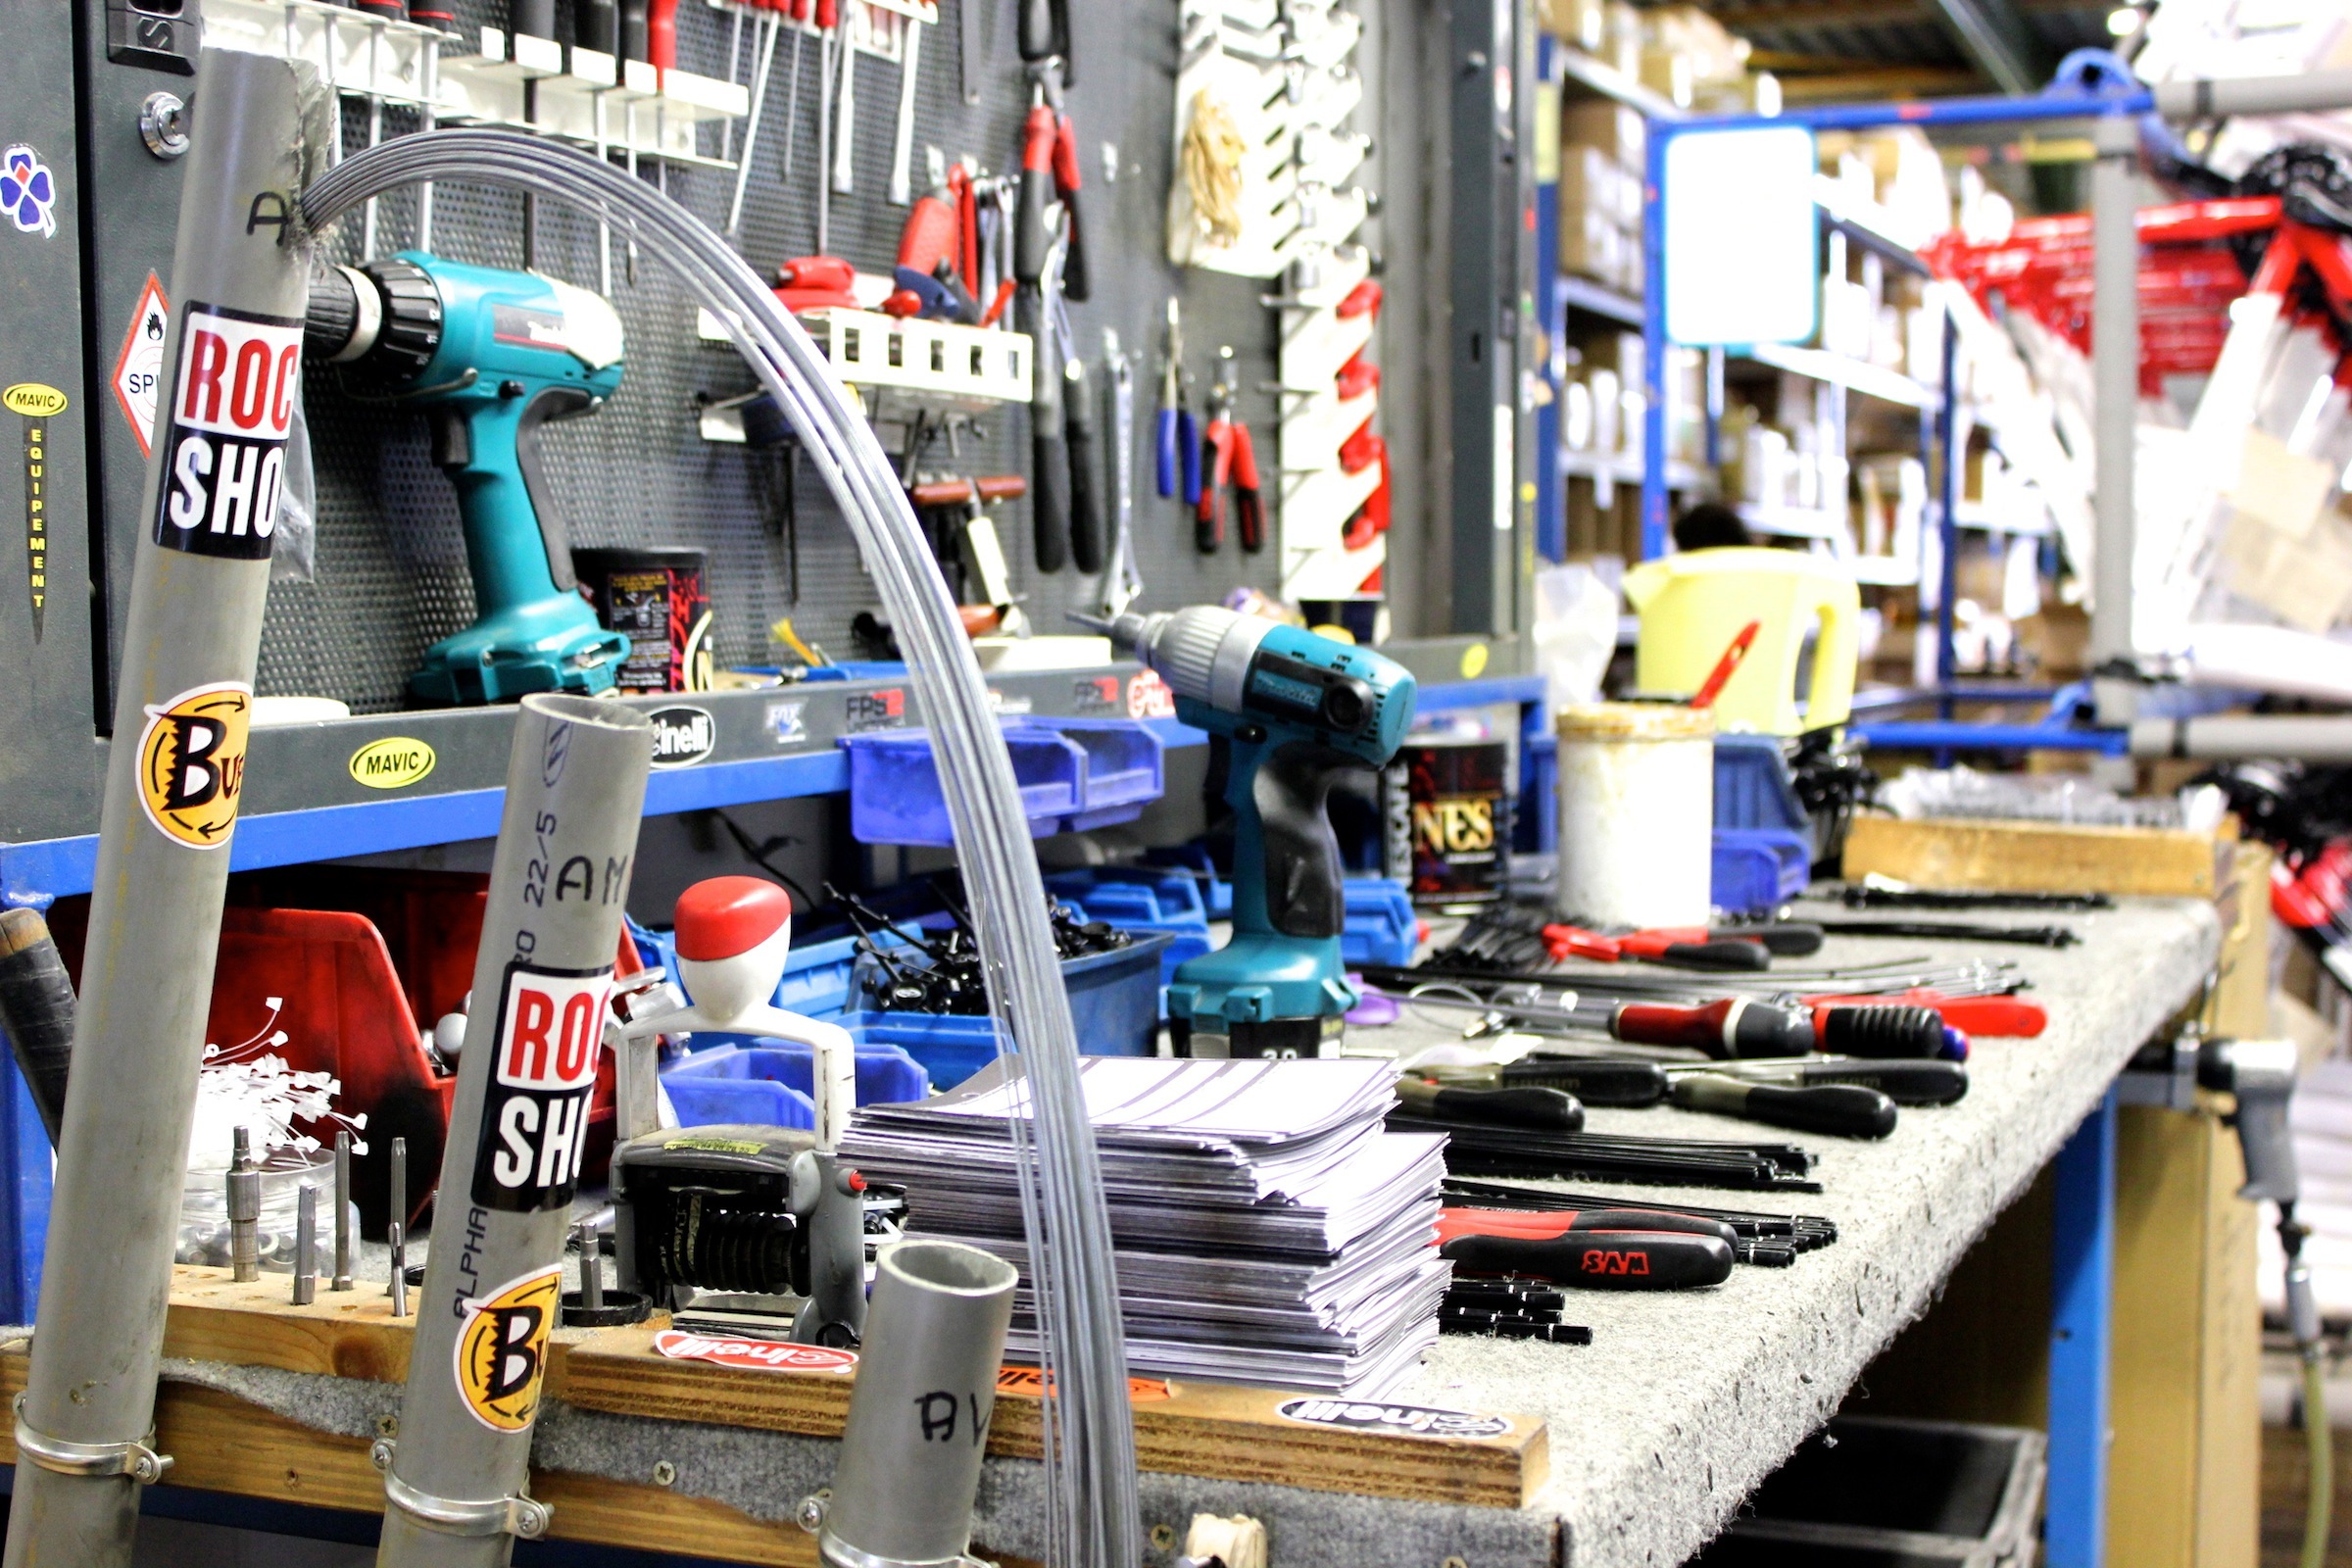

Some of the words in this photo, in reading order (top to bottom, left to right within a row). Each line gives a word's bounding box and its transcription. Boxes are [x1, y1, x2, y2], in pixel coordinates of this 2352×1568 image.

[246, 191, 289, 247] A
[15, 392, 56, 409] MAVIC
[128, 373, 160, 394] SP
[170, 436, 284, 539] SHO
[29, 428, 45, 608] EQUIPEMENT
[366, 751, 419, 775] MAVIC
[1413, 799, 1494, 854] NES
[1581, 1250, 1649, 1275] SAM
